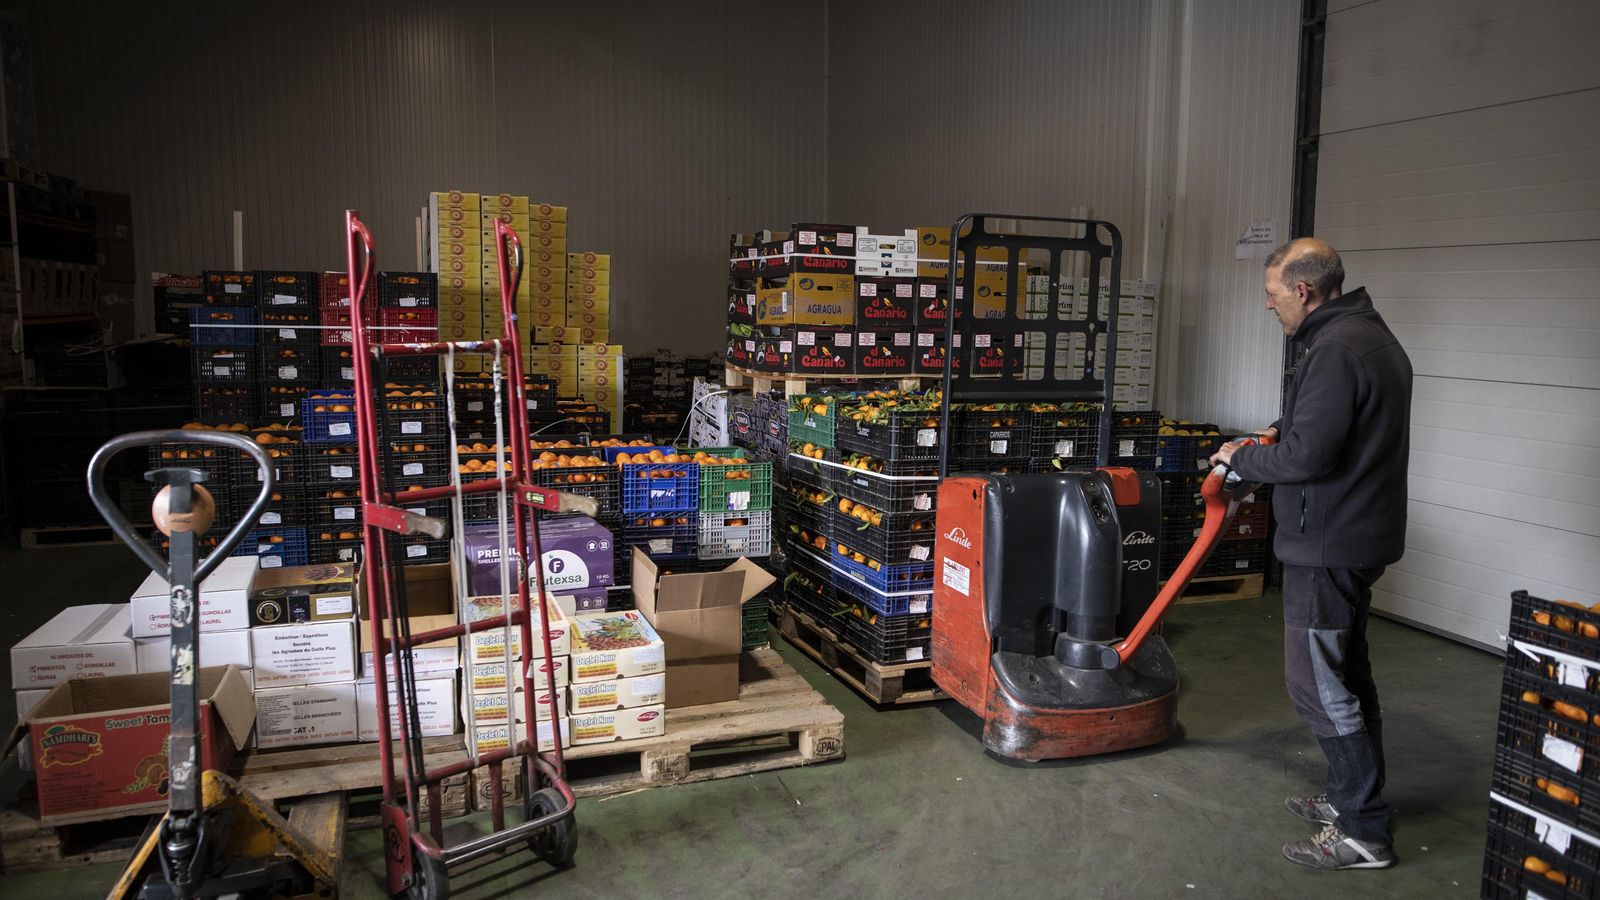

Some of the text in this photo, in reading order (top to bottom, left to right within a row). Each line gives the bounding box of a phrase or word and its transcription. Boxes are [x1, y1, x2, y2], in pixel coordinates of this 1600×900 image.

[803, 256, 848, 269] Canario
[807, 304, 842, 314] AGRAGUA
[864, 305, 907, 319] Canario
[801, 356, 846, 368] Canario
[863, 354, 906, 368] Canario
[944, 527, 972, 549] Linde
[1122, 530, 1156, 546] Linde
[477, 546, 530, 559] PREIU
[529, 575, 583, 588] Futexsa
[476, 635, 499, 645] Deglet
[576, 653, 616, 665] Deglet Nour
[576, 683, 617, 695] Deglet Nour
[105, 713, 171, 730] Sweet Tam
[575, 715, 615, 727] Deglet Nour
